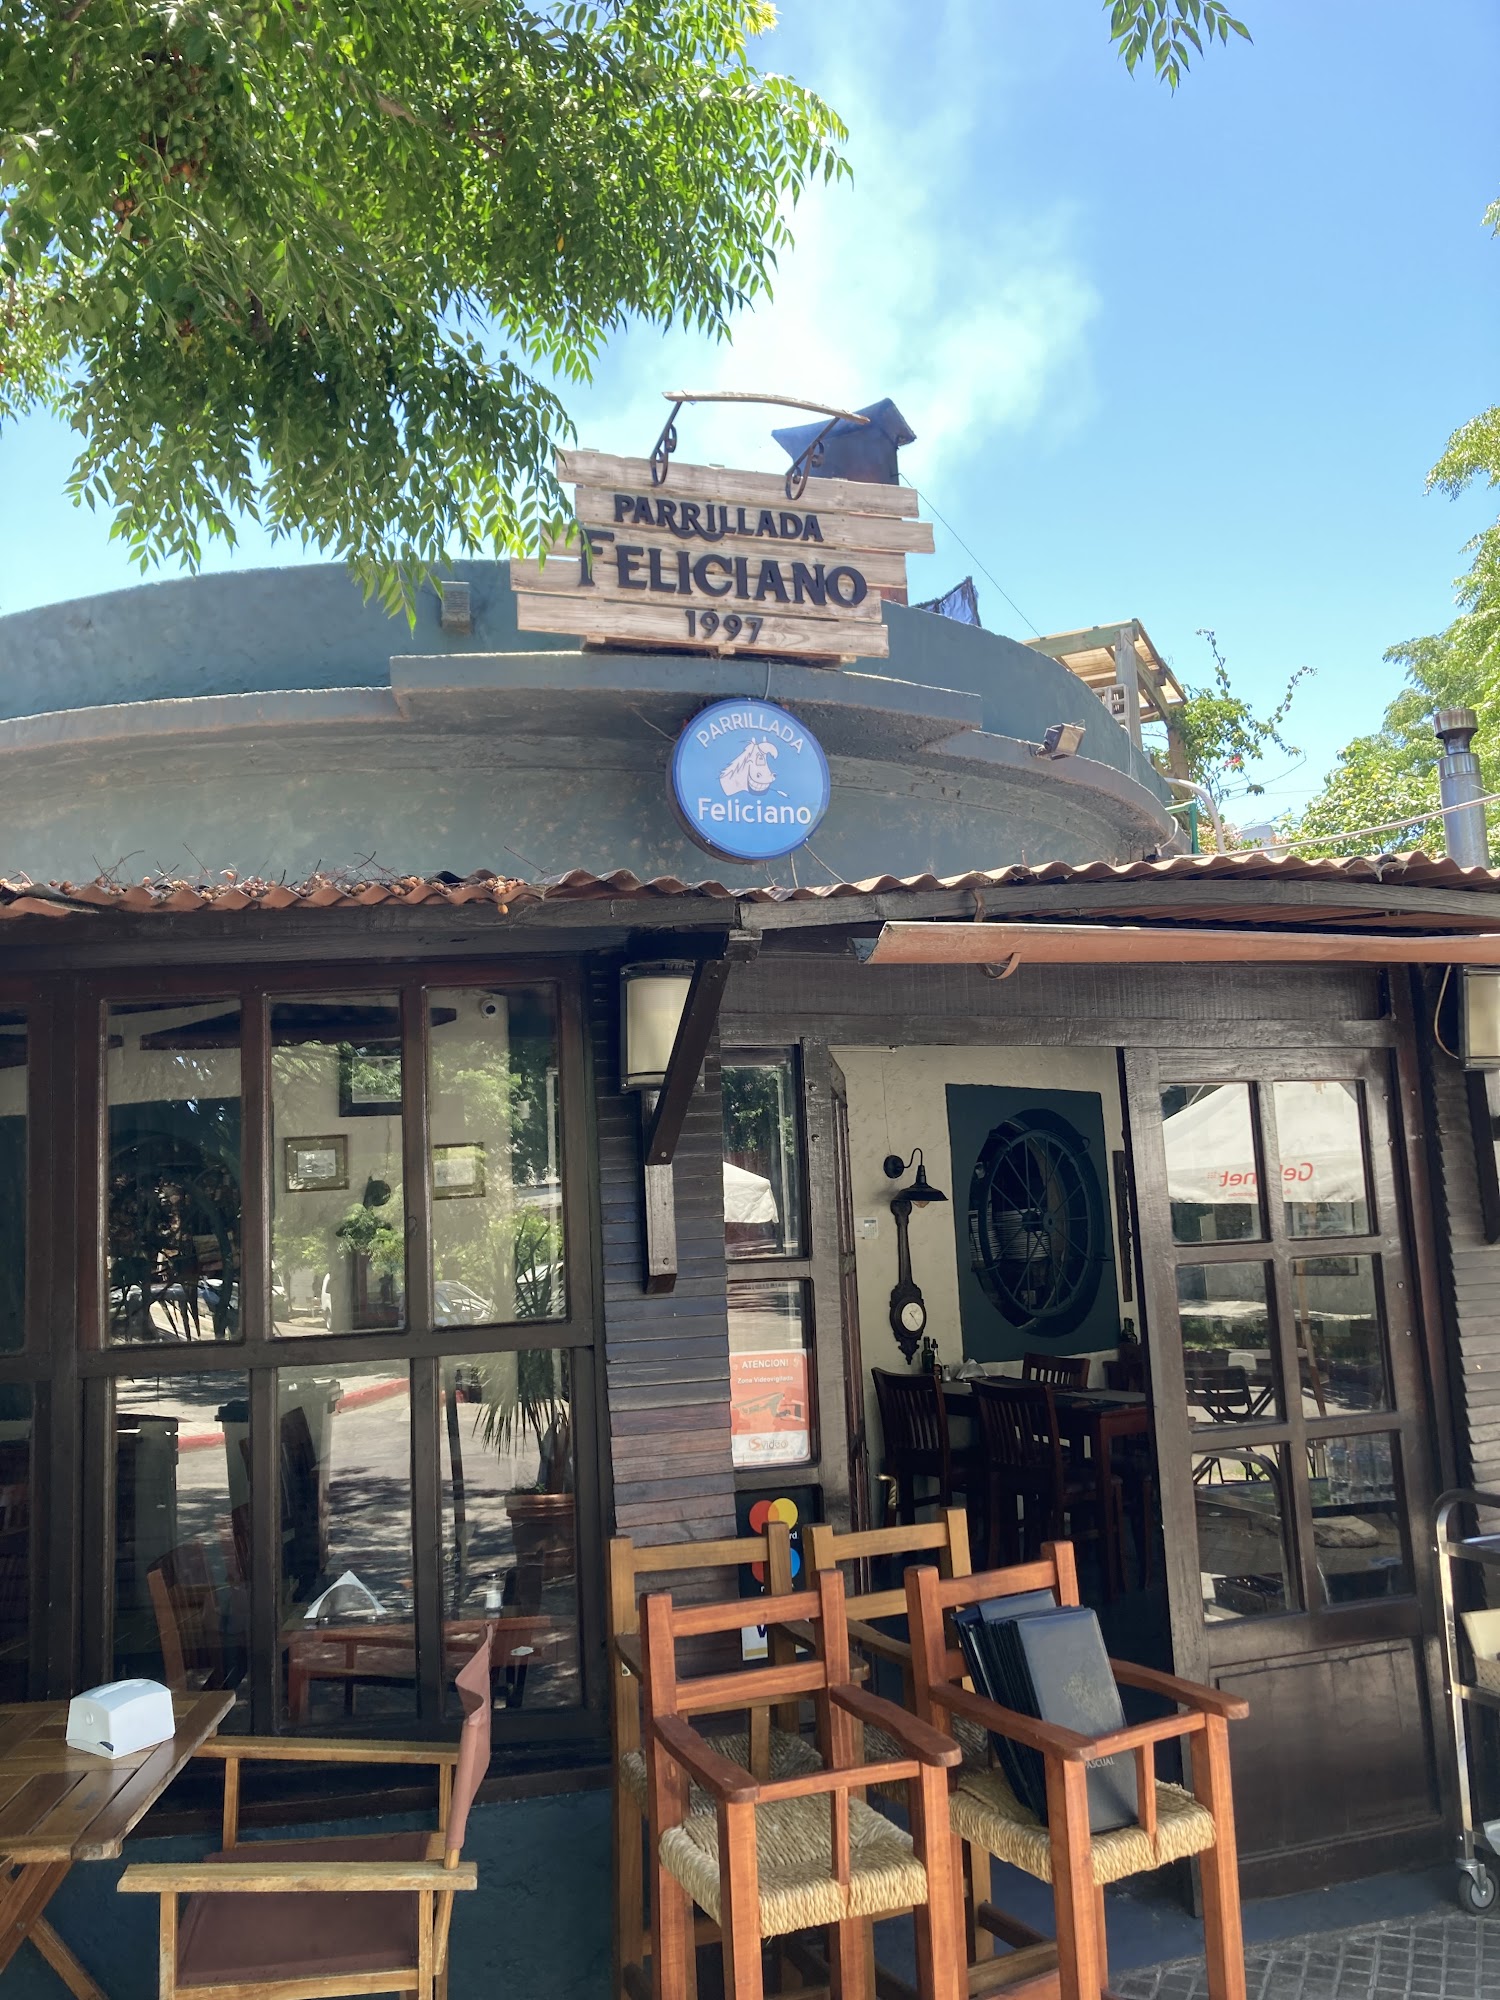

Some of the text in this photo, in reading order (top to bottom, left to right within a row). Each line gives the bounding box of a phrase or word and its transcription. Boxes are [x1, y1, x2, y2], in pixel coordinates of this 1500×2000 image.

[614, 494, 824, 543] PARRILLADA
[578, 529, 868, 608] FELICIANO
[685, 609, 764, 645] 1997
[696, 712, 805, 754] PARRILLADA
[698, 798, 812, 824] Feliciano
[1085, 1756, 1115, 1769] ASCUAL
